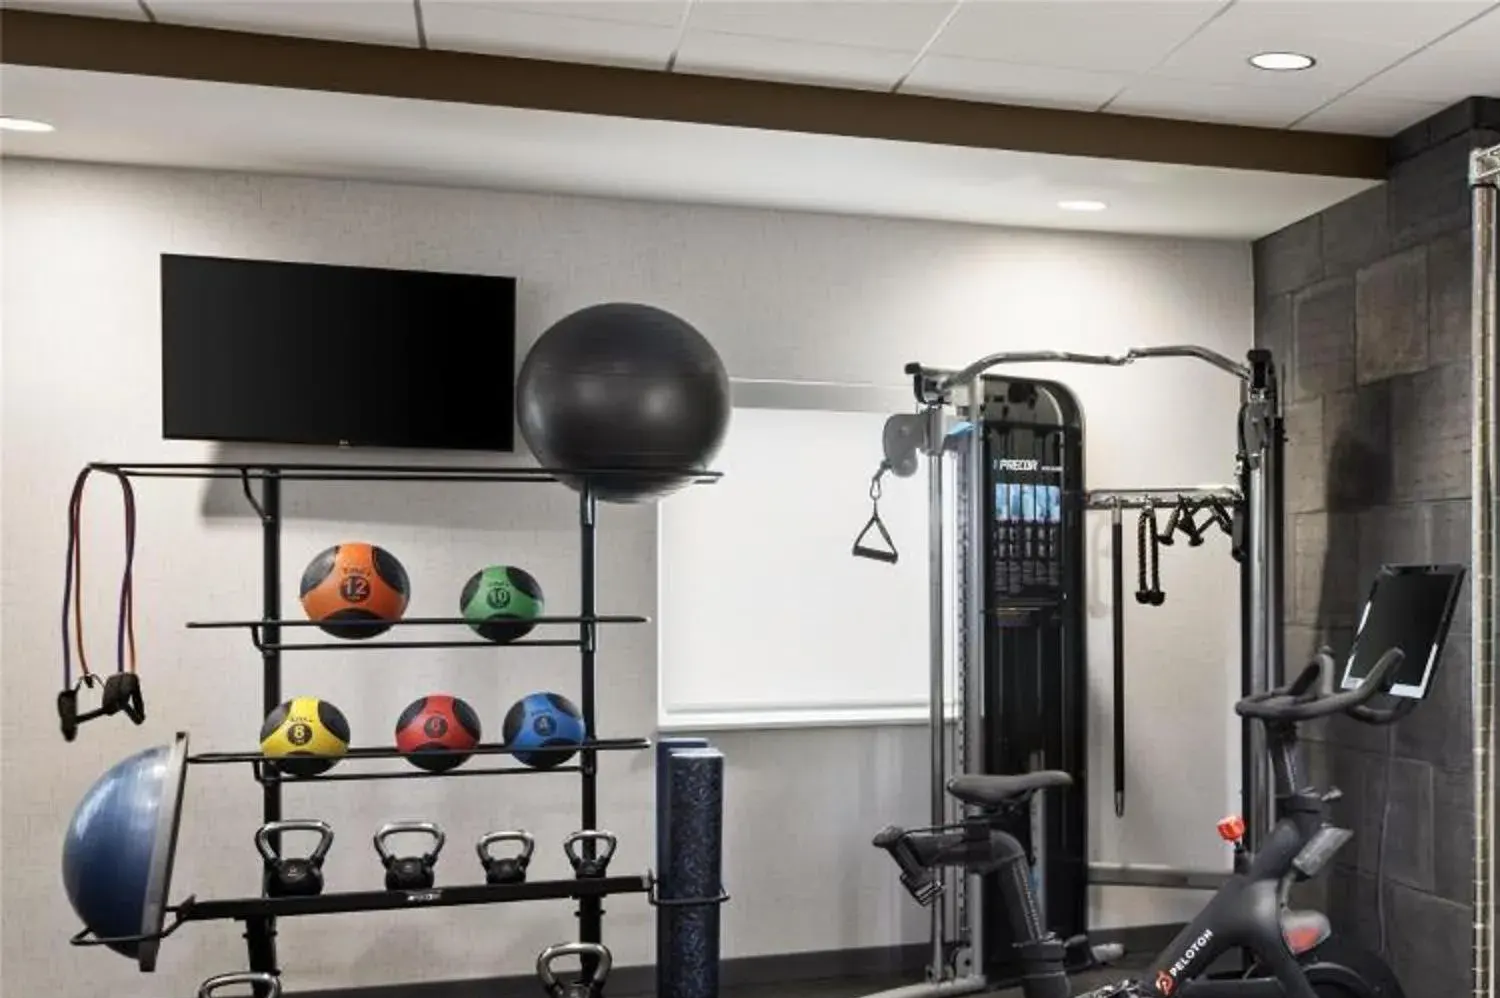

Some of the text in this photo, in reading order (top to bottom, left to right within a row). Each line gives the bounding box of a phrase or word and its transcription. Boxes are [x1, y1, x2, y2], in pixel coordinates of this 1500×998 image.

[345, 577, 368, 595] 12
[294, 725, 305, 739] 8
[1169, 928, 1214, 977] PELOTON
